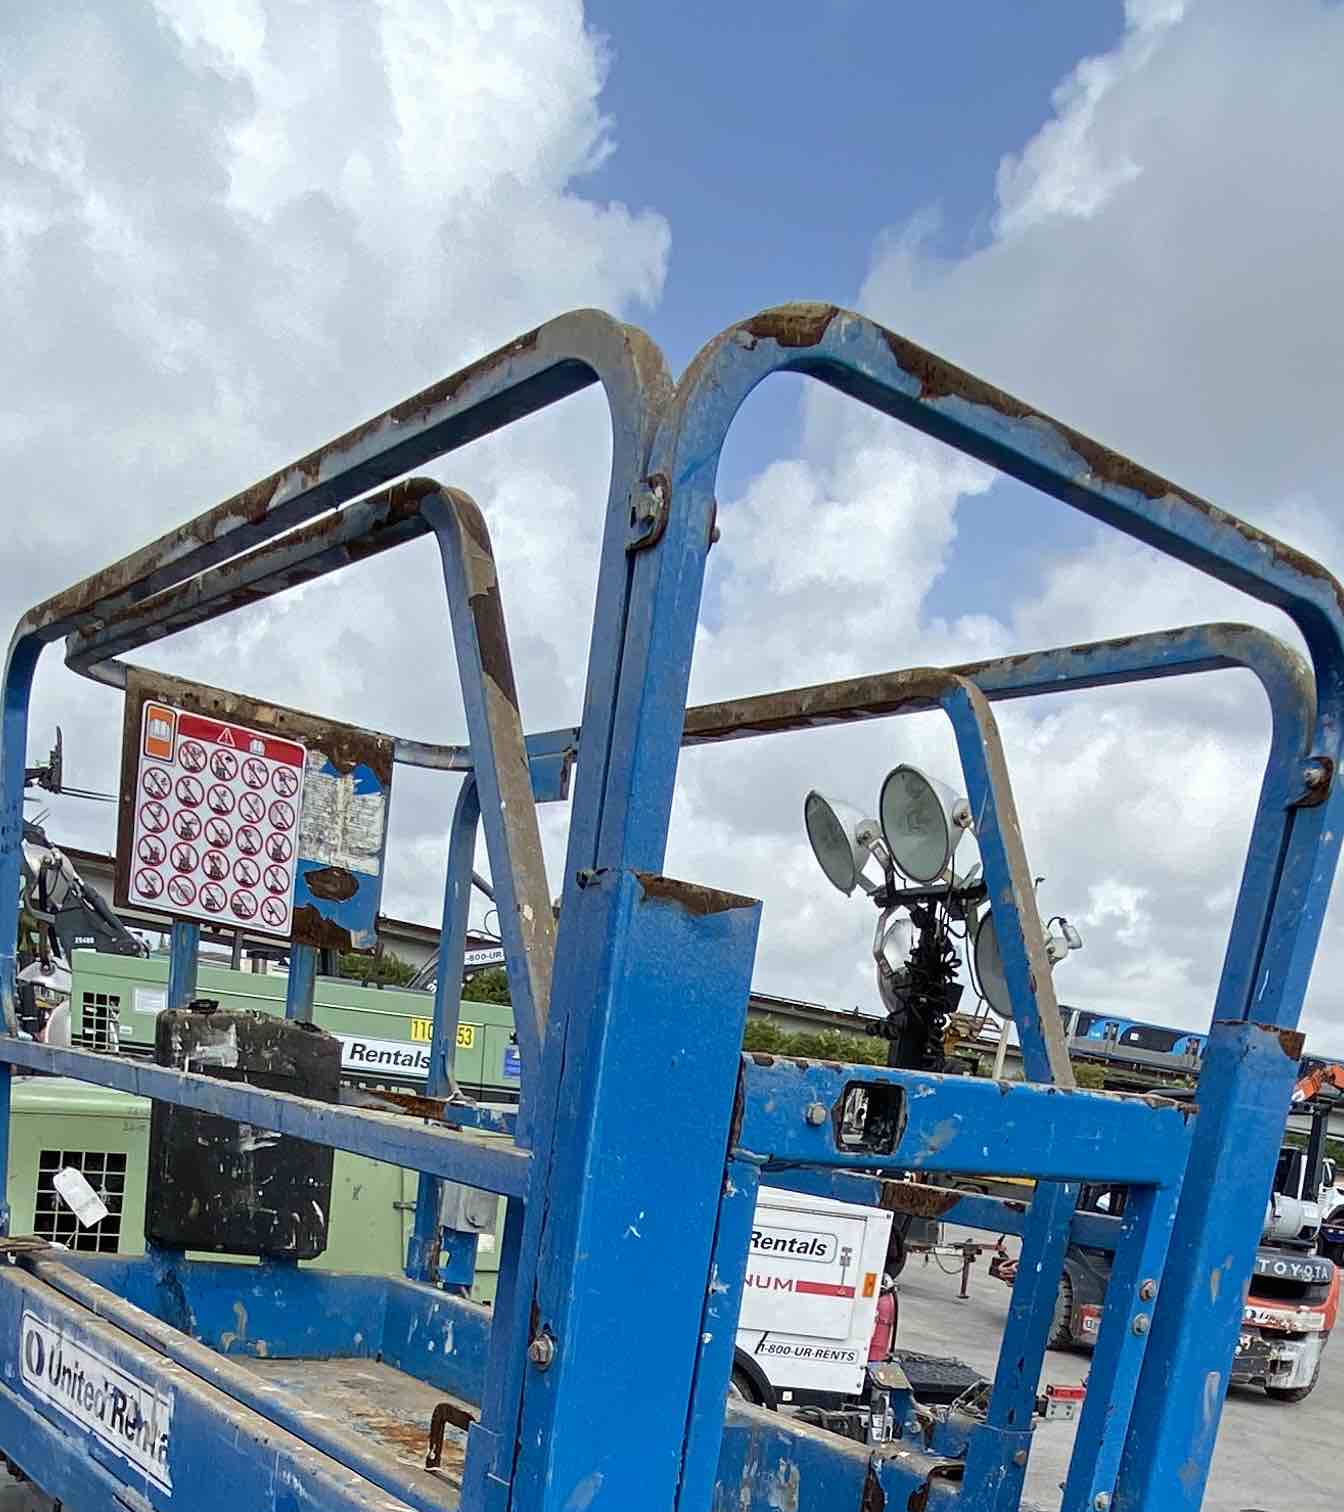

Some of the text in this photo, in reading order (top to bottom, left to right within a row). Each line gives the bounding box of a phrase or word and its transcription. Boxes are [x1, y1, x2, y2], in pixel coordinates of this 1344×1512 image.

[349, 1042, 431, 1069] Rentals
[750, 1230, 827, 1256] Rentals
[1258, 1259, 1329, 1280] TOYOTA
[759, 1342, 855, 1361] 1-800-UR-RENTS
[48, 1345, 109, 1421] United
